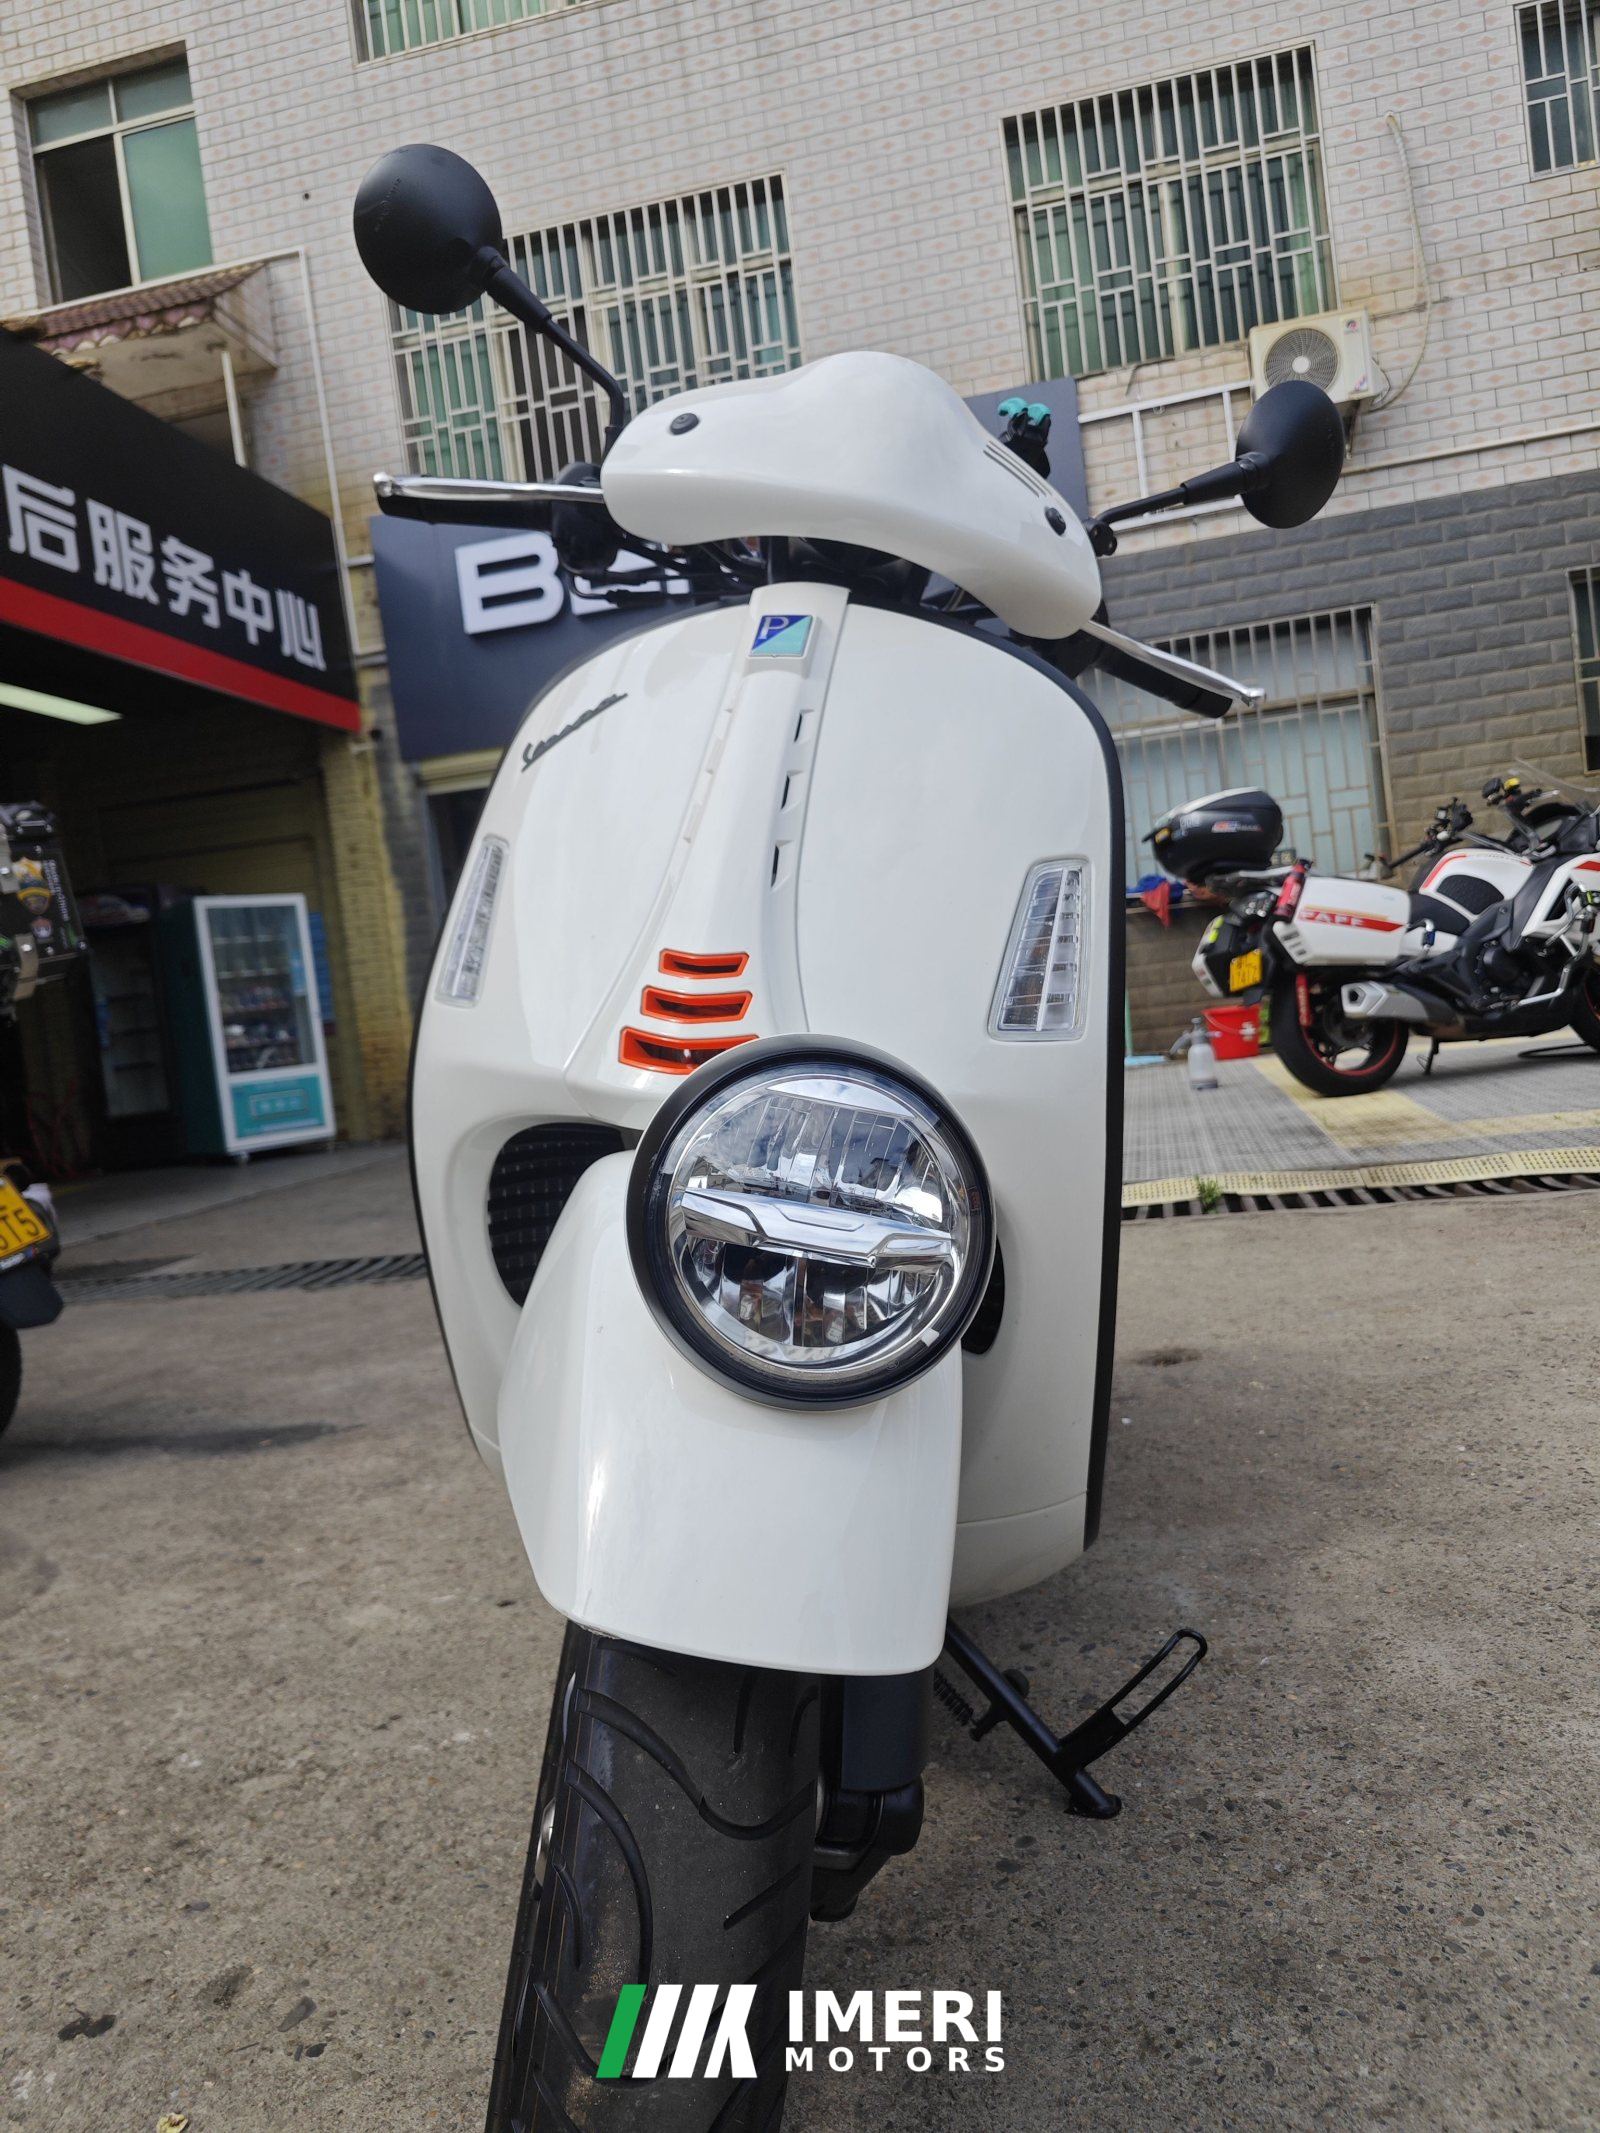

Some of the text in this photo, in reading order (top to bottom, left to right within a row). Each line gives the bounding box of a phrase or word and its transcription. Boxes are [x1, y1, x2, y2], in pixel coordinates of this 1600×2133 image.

[2, 463, 327, 671] 后服务中心
[757, 616, 789, 640] P
